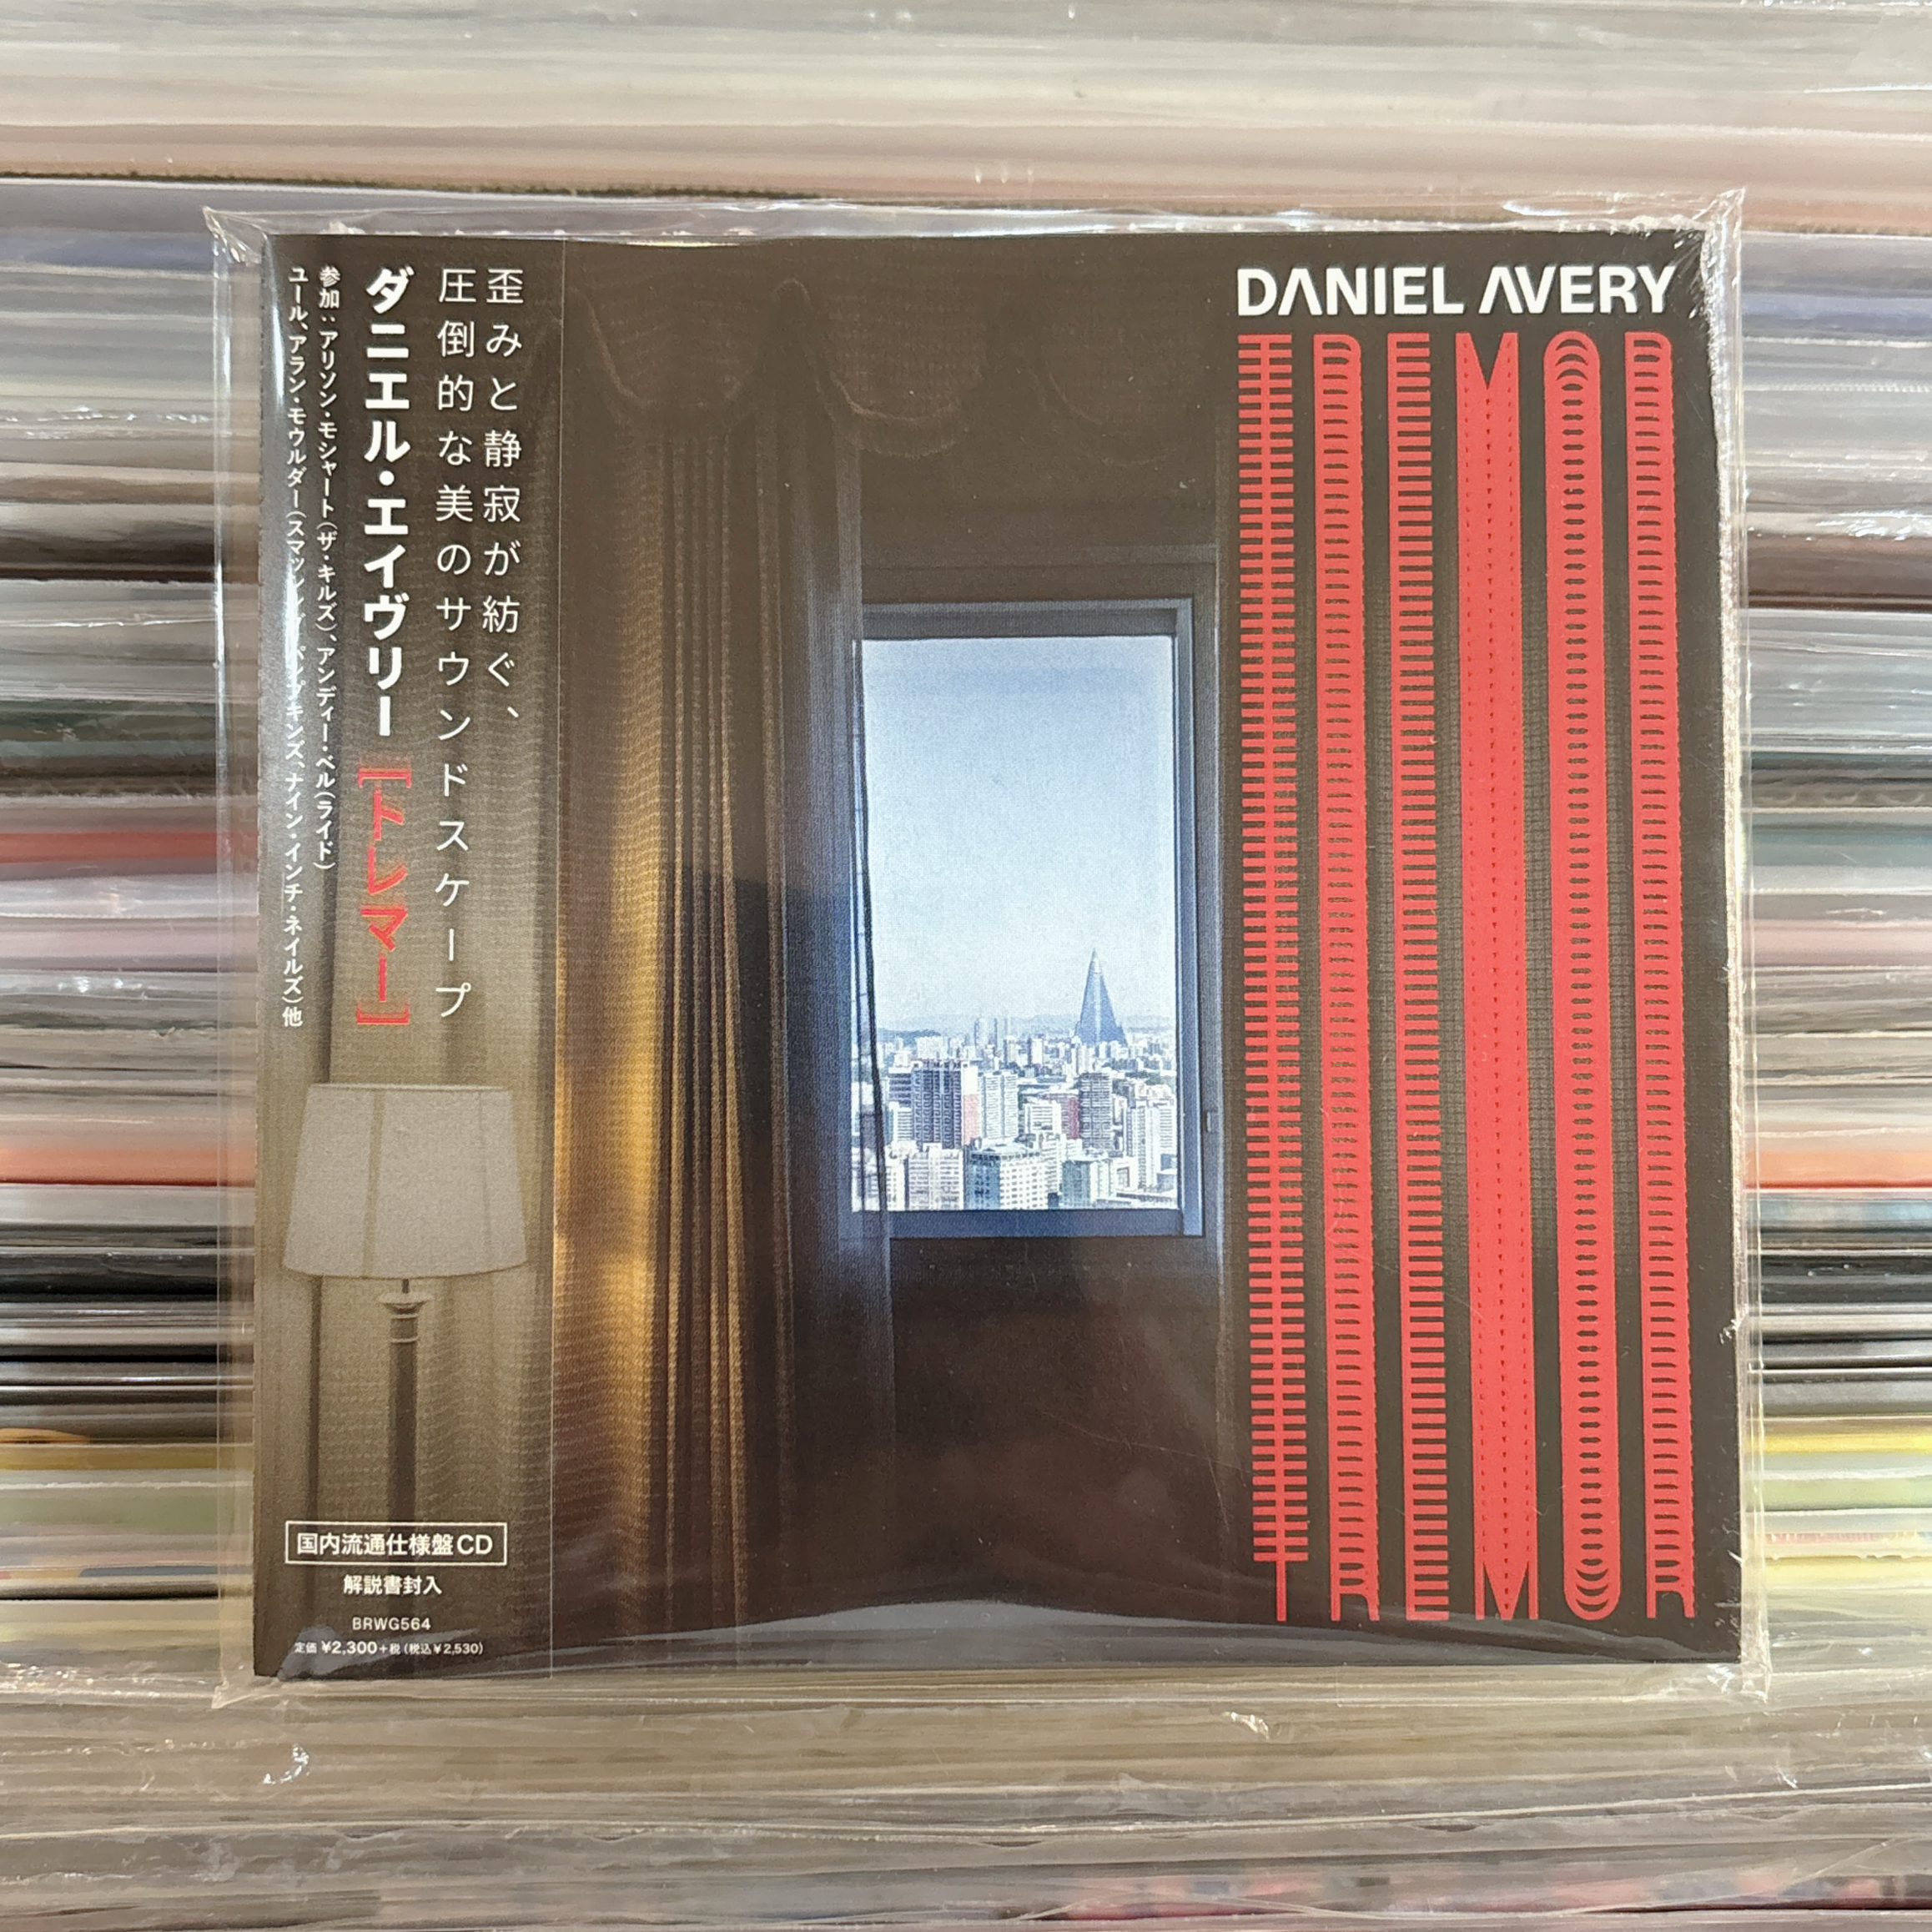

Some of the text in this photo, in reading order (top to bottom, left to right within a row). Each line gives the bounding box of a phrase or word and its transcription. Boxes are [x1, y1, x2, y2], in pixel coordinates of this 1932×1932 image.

[1237, 264, 1677, 316] DANIEL AVERY
[364, 264, 415, 737] ダニエル・エイヴリー
[482, 268, 525, 718] 歪みと静寂が紡ぐ、
[435, 268, 477, 1018] 圧倒的な美のサウンドスケープ
[1238, 330, 1696, 1622] TREMOR
[296, 1532, 493, 1557] 国内流通仕様盤CD
[343, 1574, 443, 1596] 解説書封入
[294, 1641, 319, 1655] 定価
[352, 1617, 432, 1631] BRWG564
